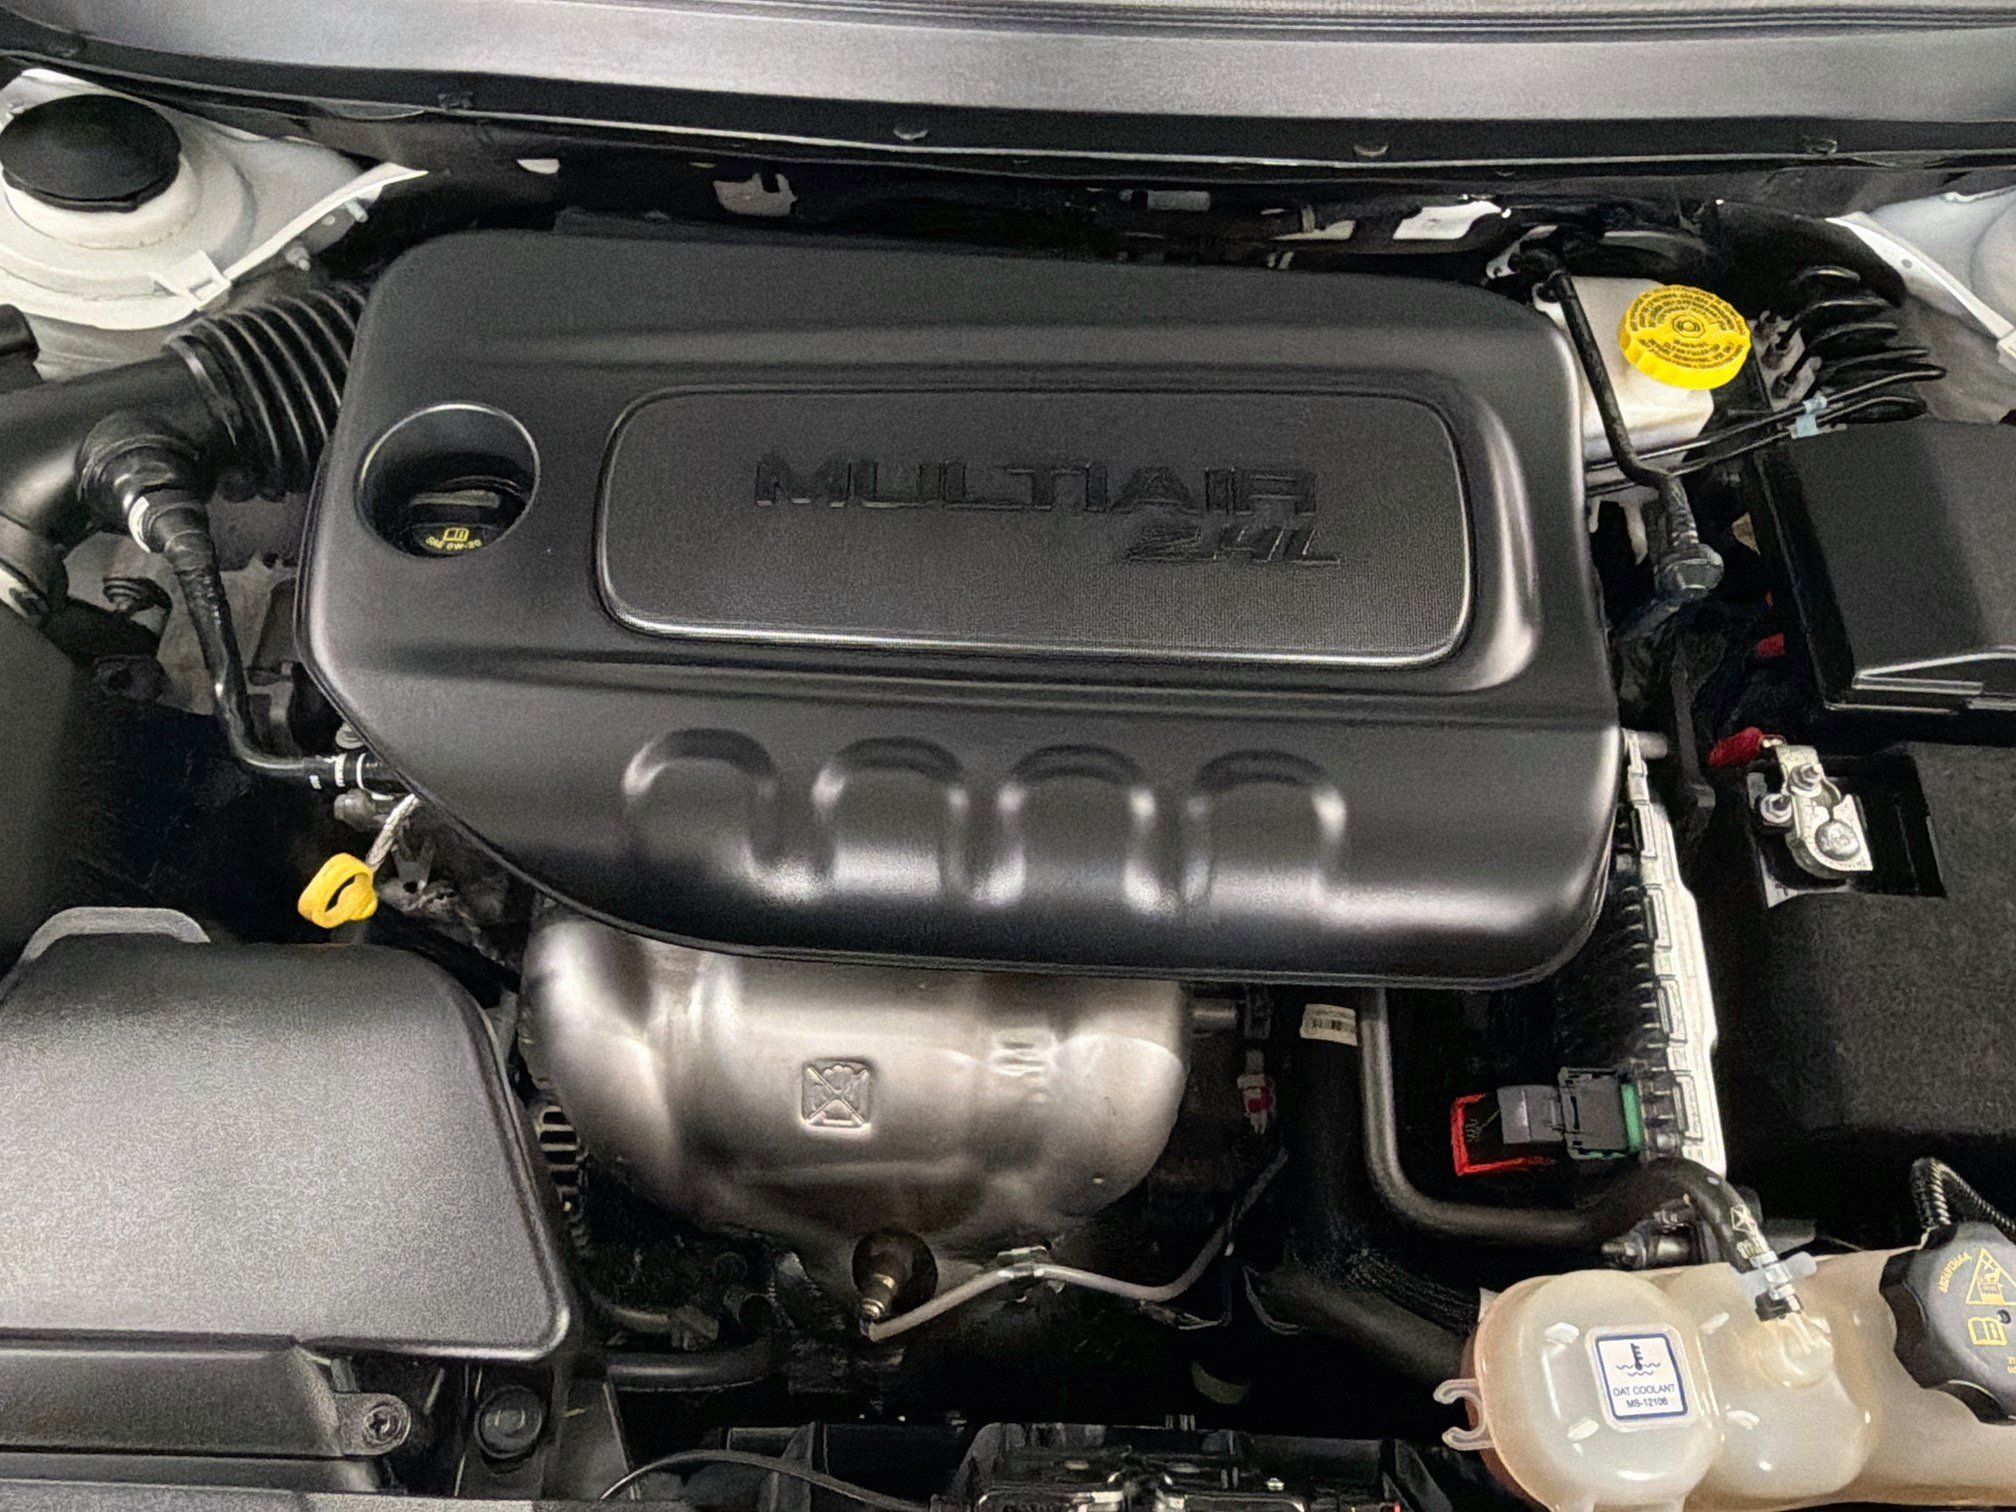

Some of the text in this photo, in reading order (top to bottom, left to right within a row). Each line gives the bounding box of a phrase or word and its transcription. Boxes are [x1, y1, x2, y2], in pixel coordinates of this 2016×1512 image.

[755, 454, 1317, 515] MULTIAIR
[1613, 1384, 1675, 1397] OAT COOLANT
